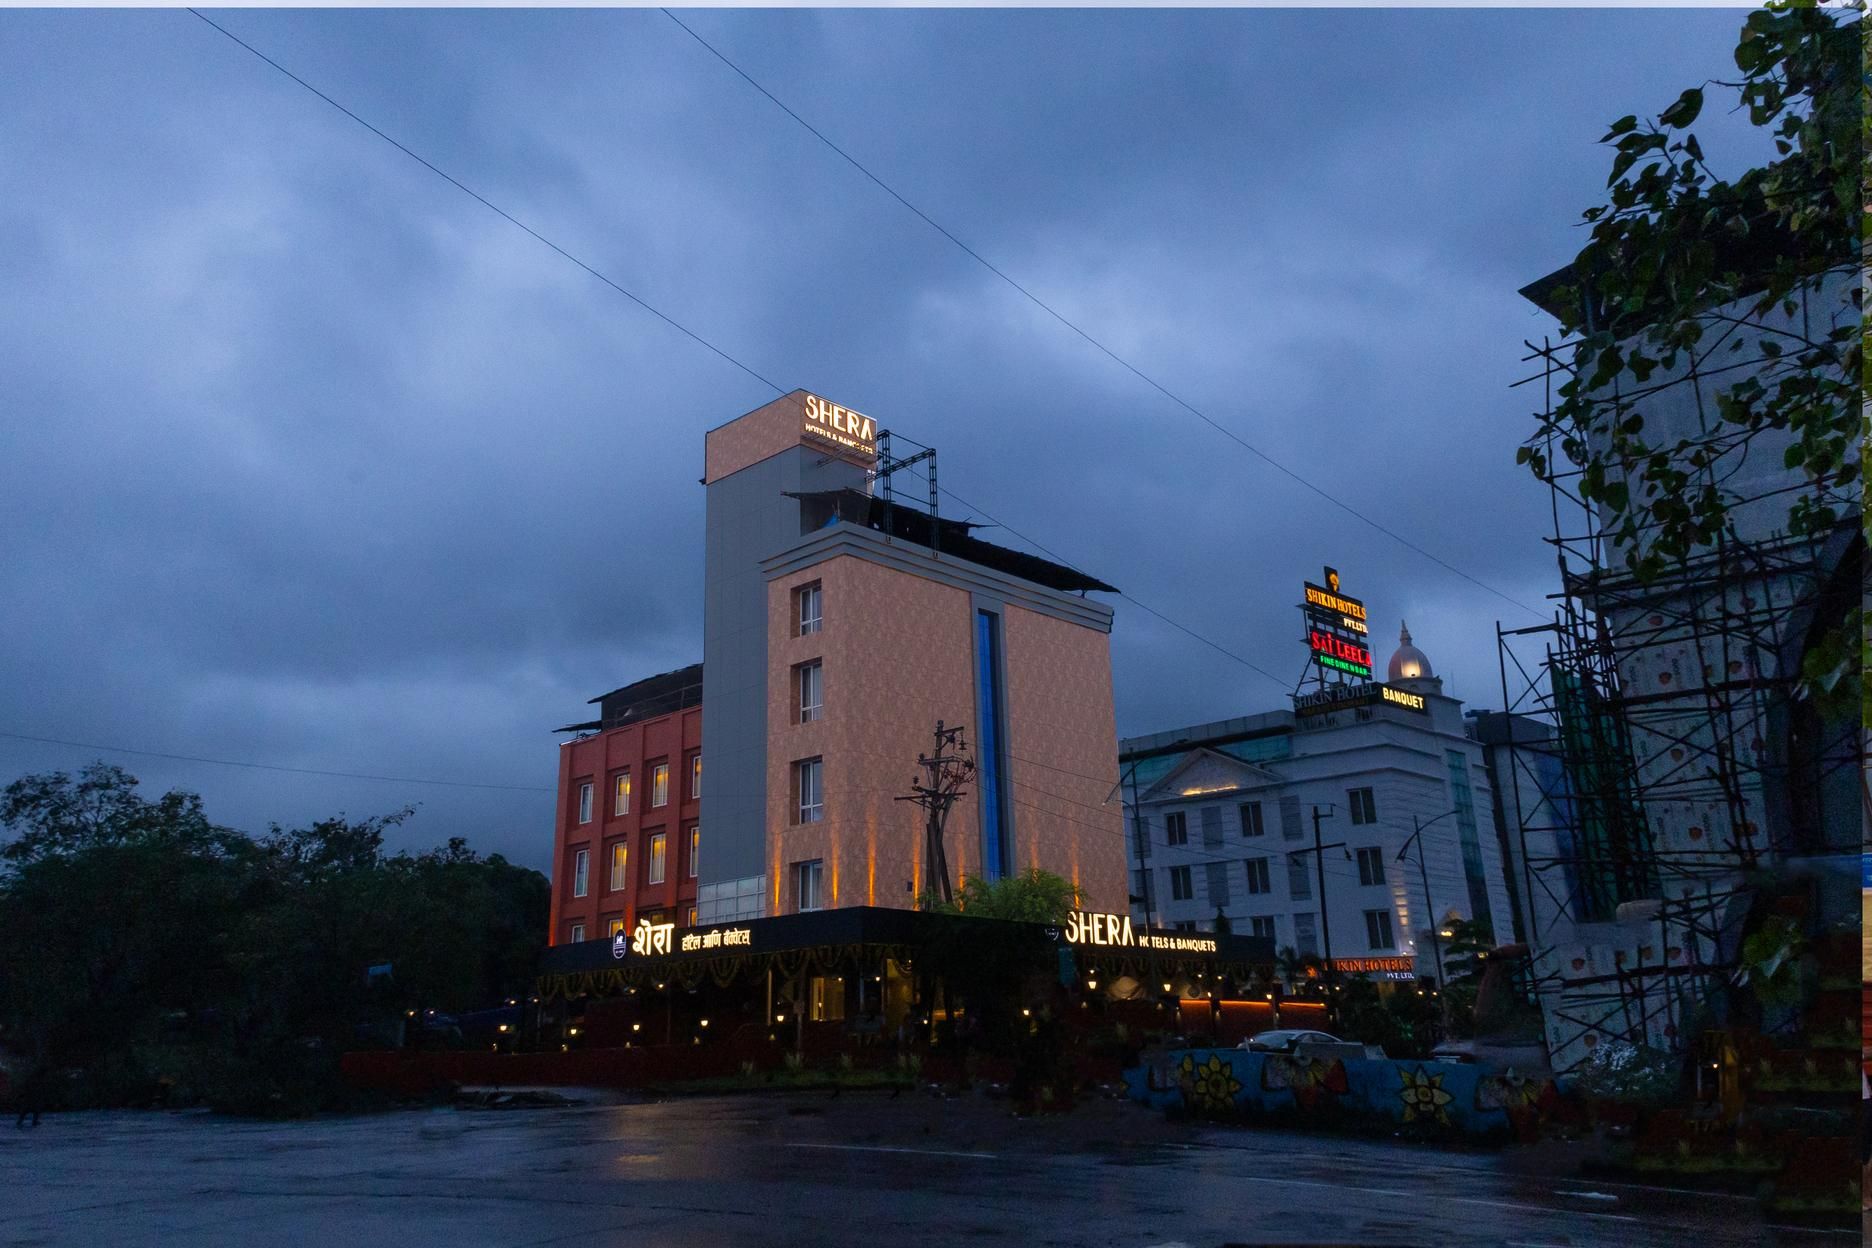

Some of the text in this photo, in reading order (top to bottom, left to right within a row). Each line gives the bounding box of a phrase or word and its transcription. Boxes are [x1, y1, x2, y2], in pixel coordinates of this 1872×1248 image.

[805, 395, 873, 441] SHERA
[1307, 588, 1366, 620] SHIKIN HOTELS
[1336, 639, 1372, 666] LEELA
[1383, 687, 1424, 709] BANQUET
[632, 918, 675, 956] शेरा
[702, 930, 722, 948] आणि
[1065, 911, 1134, 946] SHERA
[1169, 937, 1176, 949] &
[1176, 938, 1216, 952] BANQUETS
[1364, 958, 1412, 972] HOTELS
